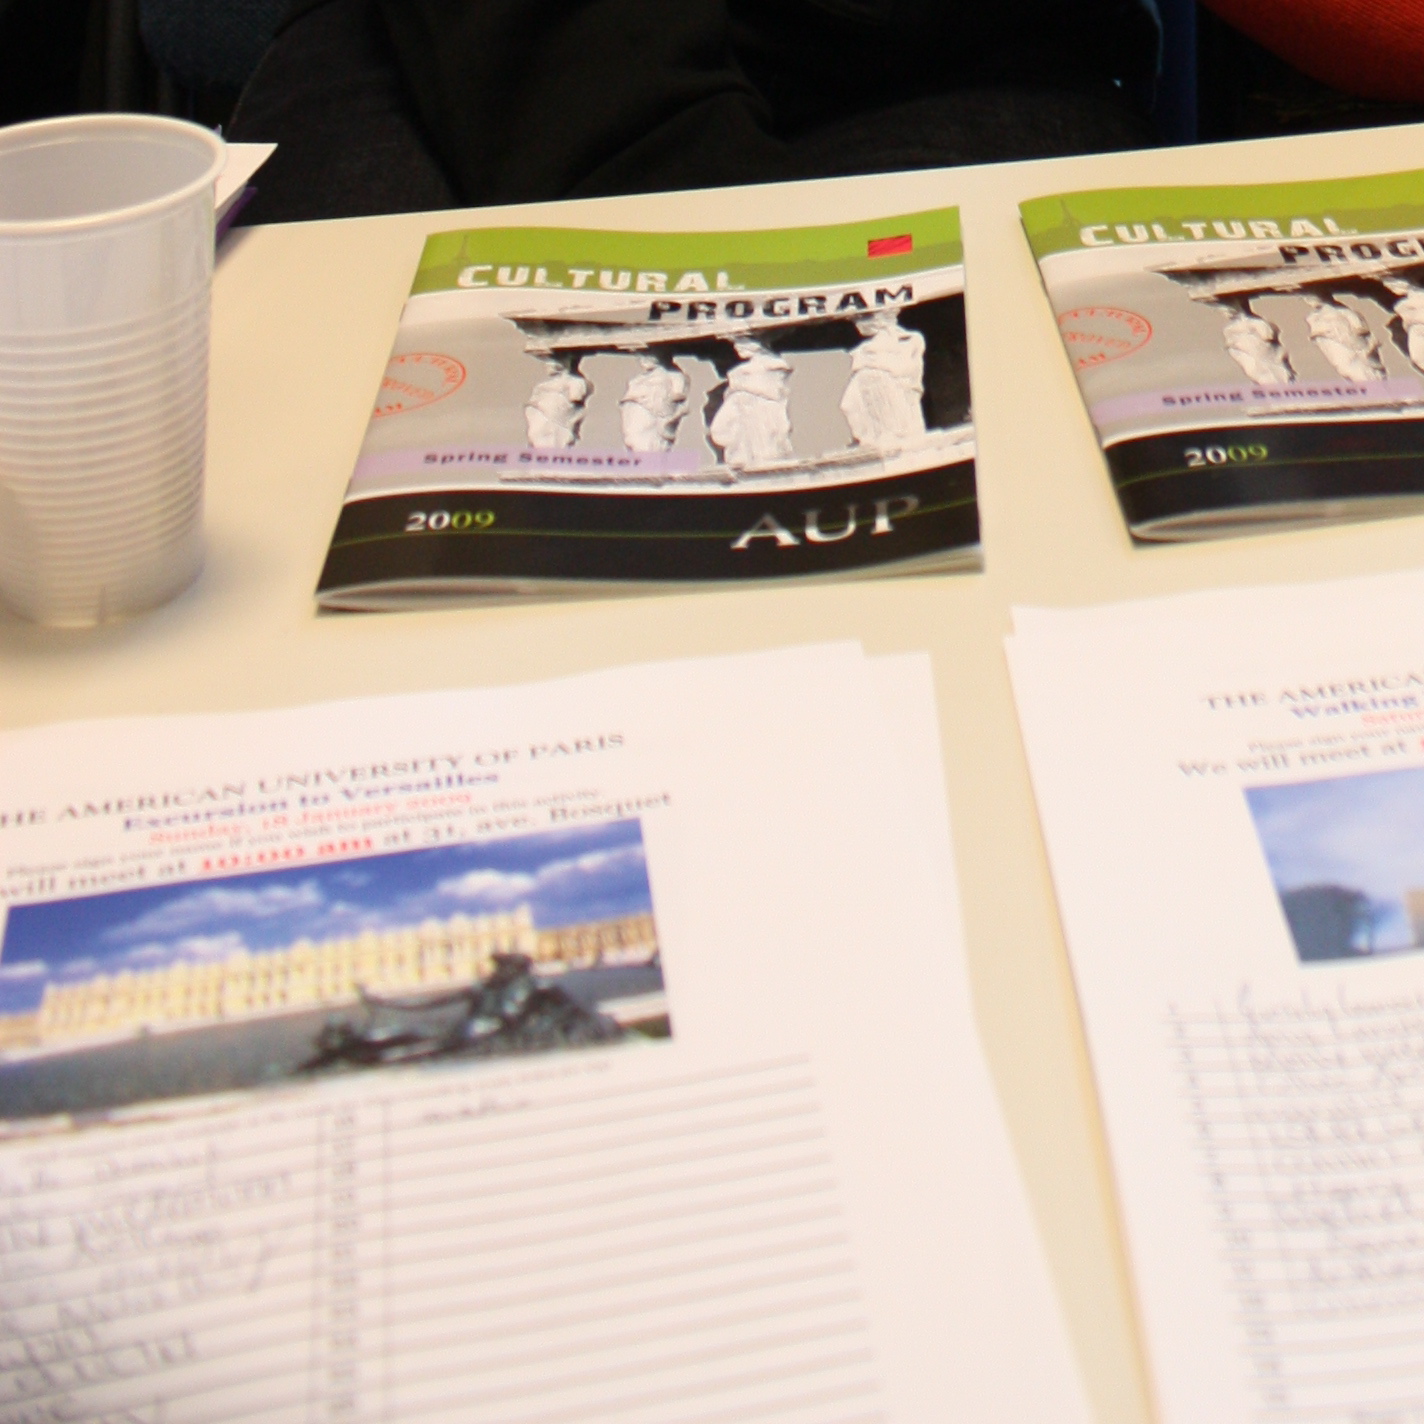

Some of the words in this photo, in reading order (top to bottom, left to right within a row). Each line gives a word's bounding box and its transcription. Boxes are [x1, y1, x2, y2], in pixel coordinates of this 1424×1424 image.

[1079, 216, 1358, 248] CULTURAL
[457, 264, 746, 292] CULTURAL
[647, 284, 914, 322] PROGRAM
[1162, 390, 1244, 408] Spring
[1252, 383, 1369, 402] Semester
[424, 451, 509, 466] Spring
[518, 451, 643, 467] Semester
[1184, 443, 1269, 468] 2009
[404, 510, 495, 533] 2009
[730, 494, 919, 550] AUP
[1204, 688, 1267, 711] THE
[1290, 692, 1421, 720] Walking
[1236, 751, 1290, 772] will
[1296, 741, 1371, 765] meet
[56, 779, 248, 824] AMERICAN
[257, 755, 466, 795] UNIVERSITY
[473, 749, 520, 767] OF
[528, 730, 626, 761] PARIS
[122, 798, 289, 832] Excursion
[298, 792, 332, 808] to
[340, 770, 500, 802] Versailles
[67, 864, 147, 891] meet
[550, 790, 674, 820] Bosquet
